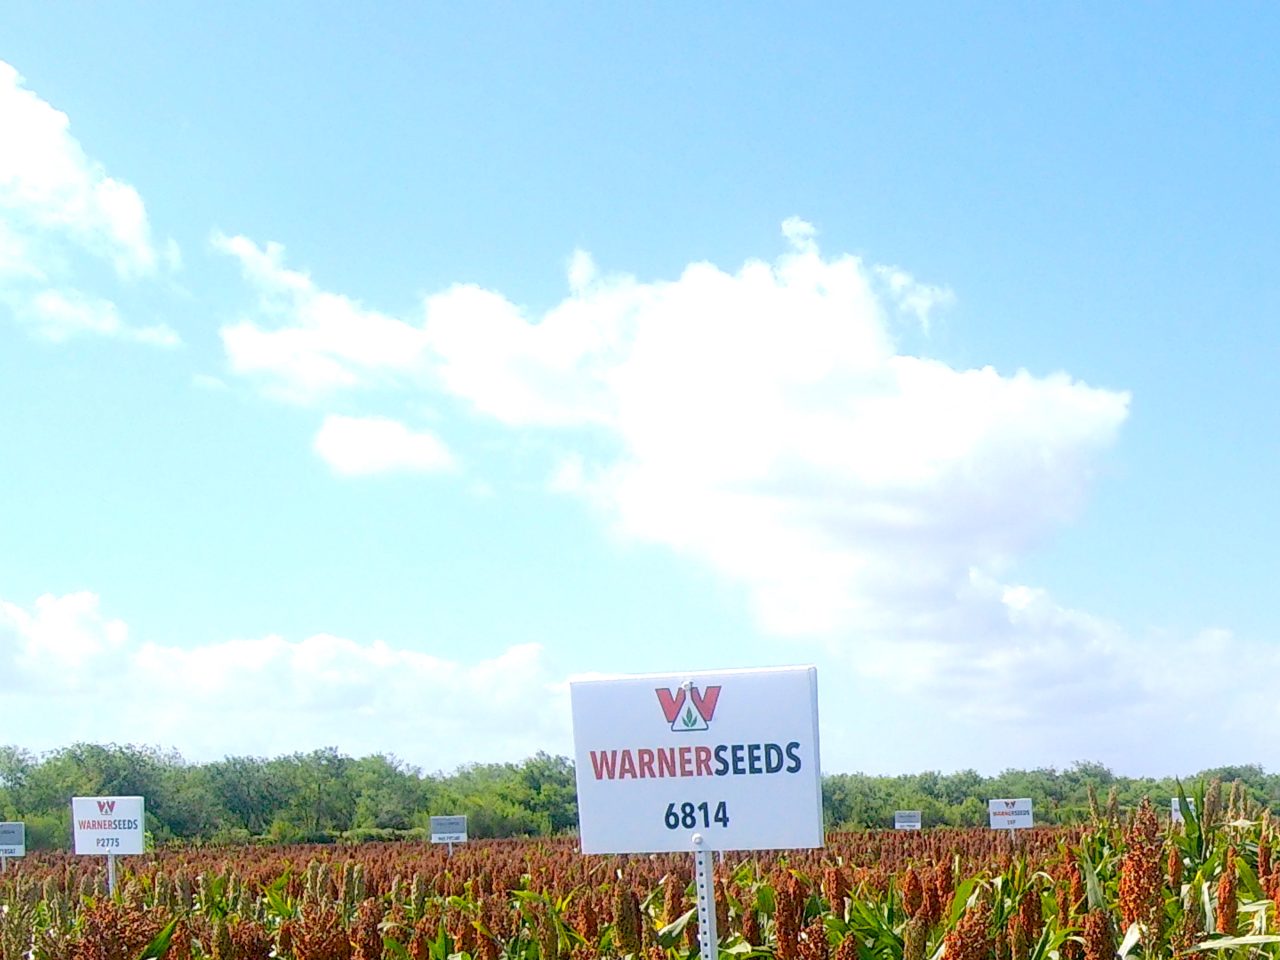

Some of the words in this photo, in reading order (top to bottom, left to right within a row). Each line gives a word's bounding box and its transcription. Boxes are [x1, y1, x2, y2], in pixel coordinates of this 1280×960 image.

[590, 742, 801, 780] WARNERSEEDS
[78, 819, 138, 830] WARNERSEEDS
[664, 801, 729, 829] 6814
